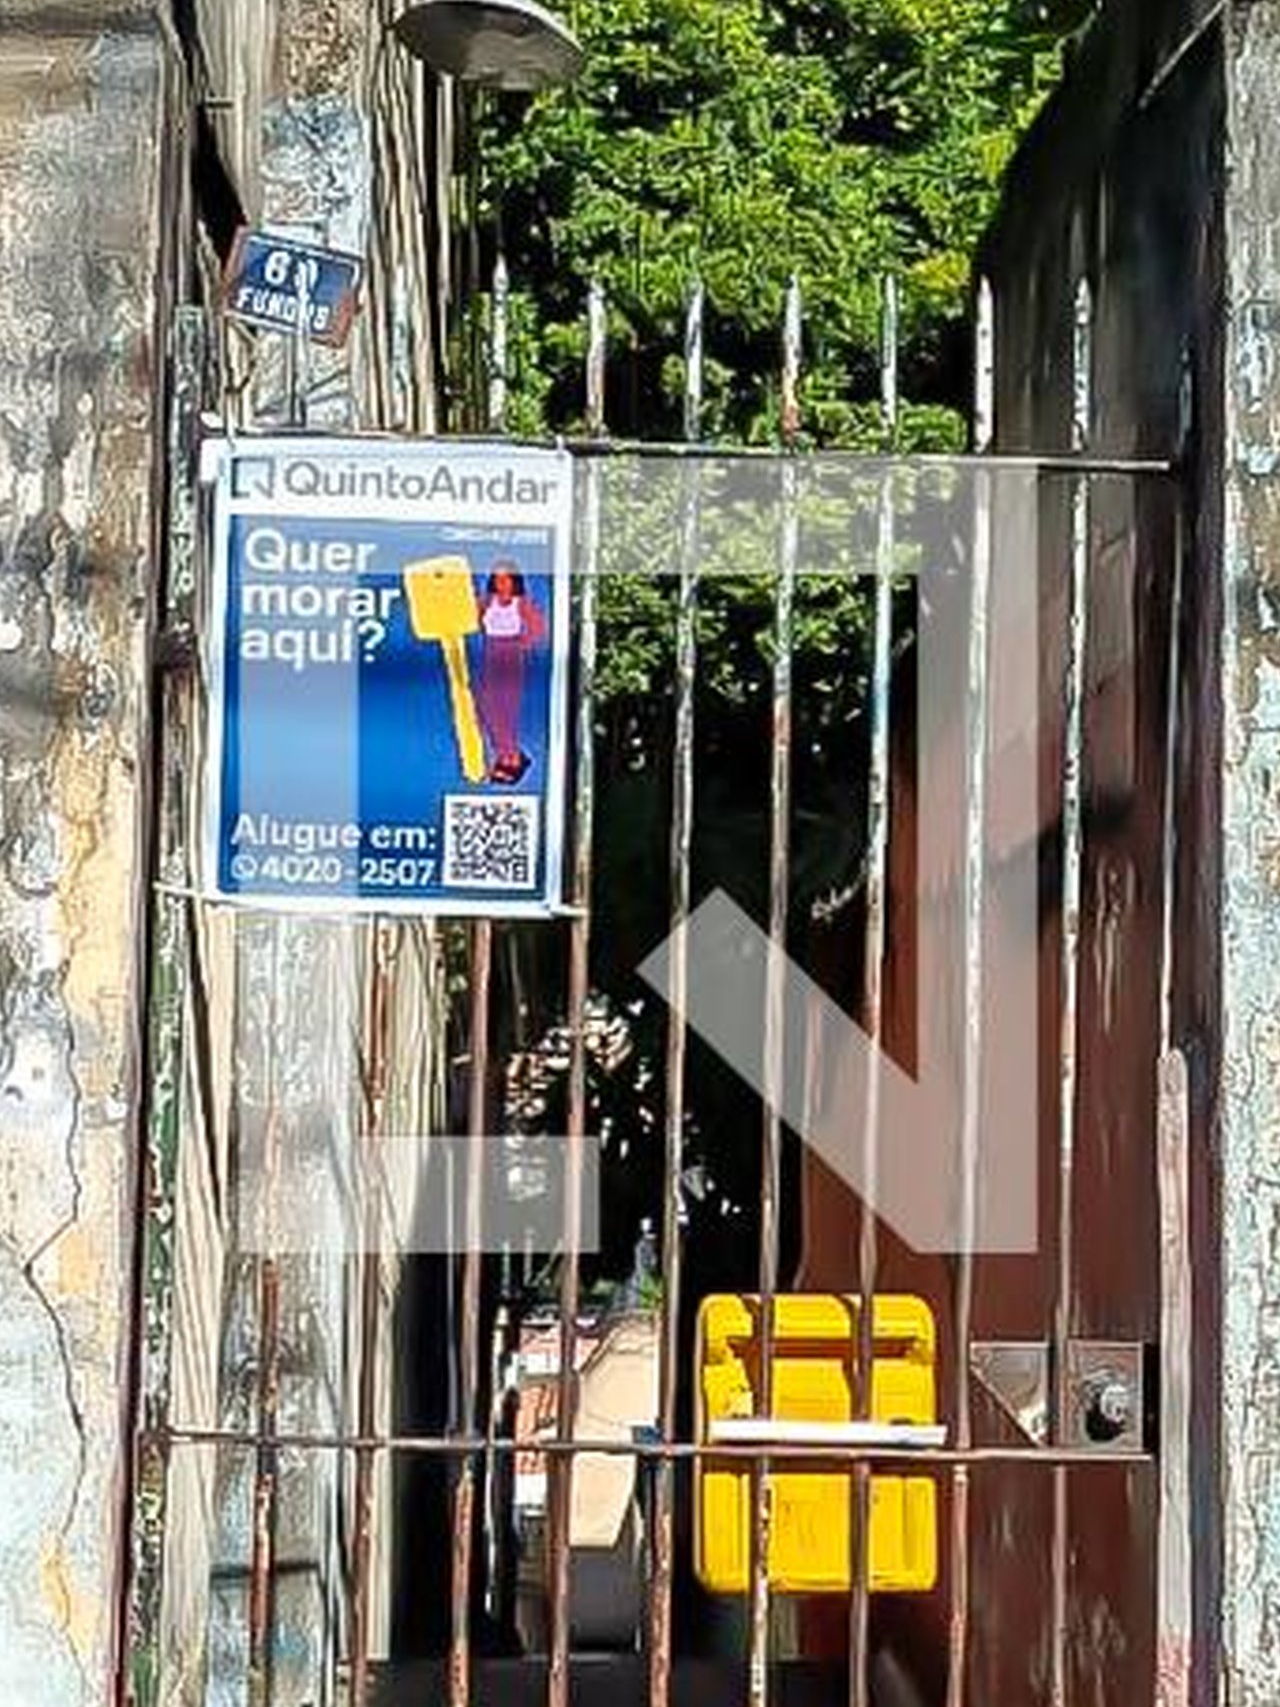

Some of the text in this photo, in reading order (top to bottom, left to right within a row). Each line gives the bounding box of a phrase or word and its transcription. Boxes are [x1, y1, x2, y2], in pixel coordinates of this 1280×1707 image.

[236, 286, 330, 329] FUNDS
[285, 460, 558, 505] QuintoAndar
[245, 527, 378, 573] Quer
[241, 583, 401, 619] morar
[230, 813, 437, 854] Alugue em:
